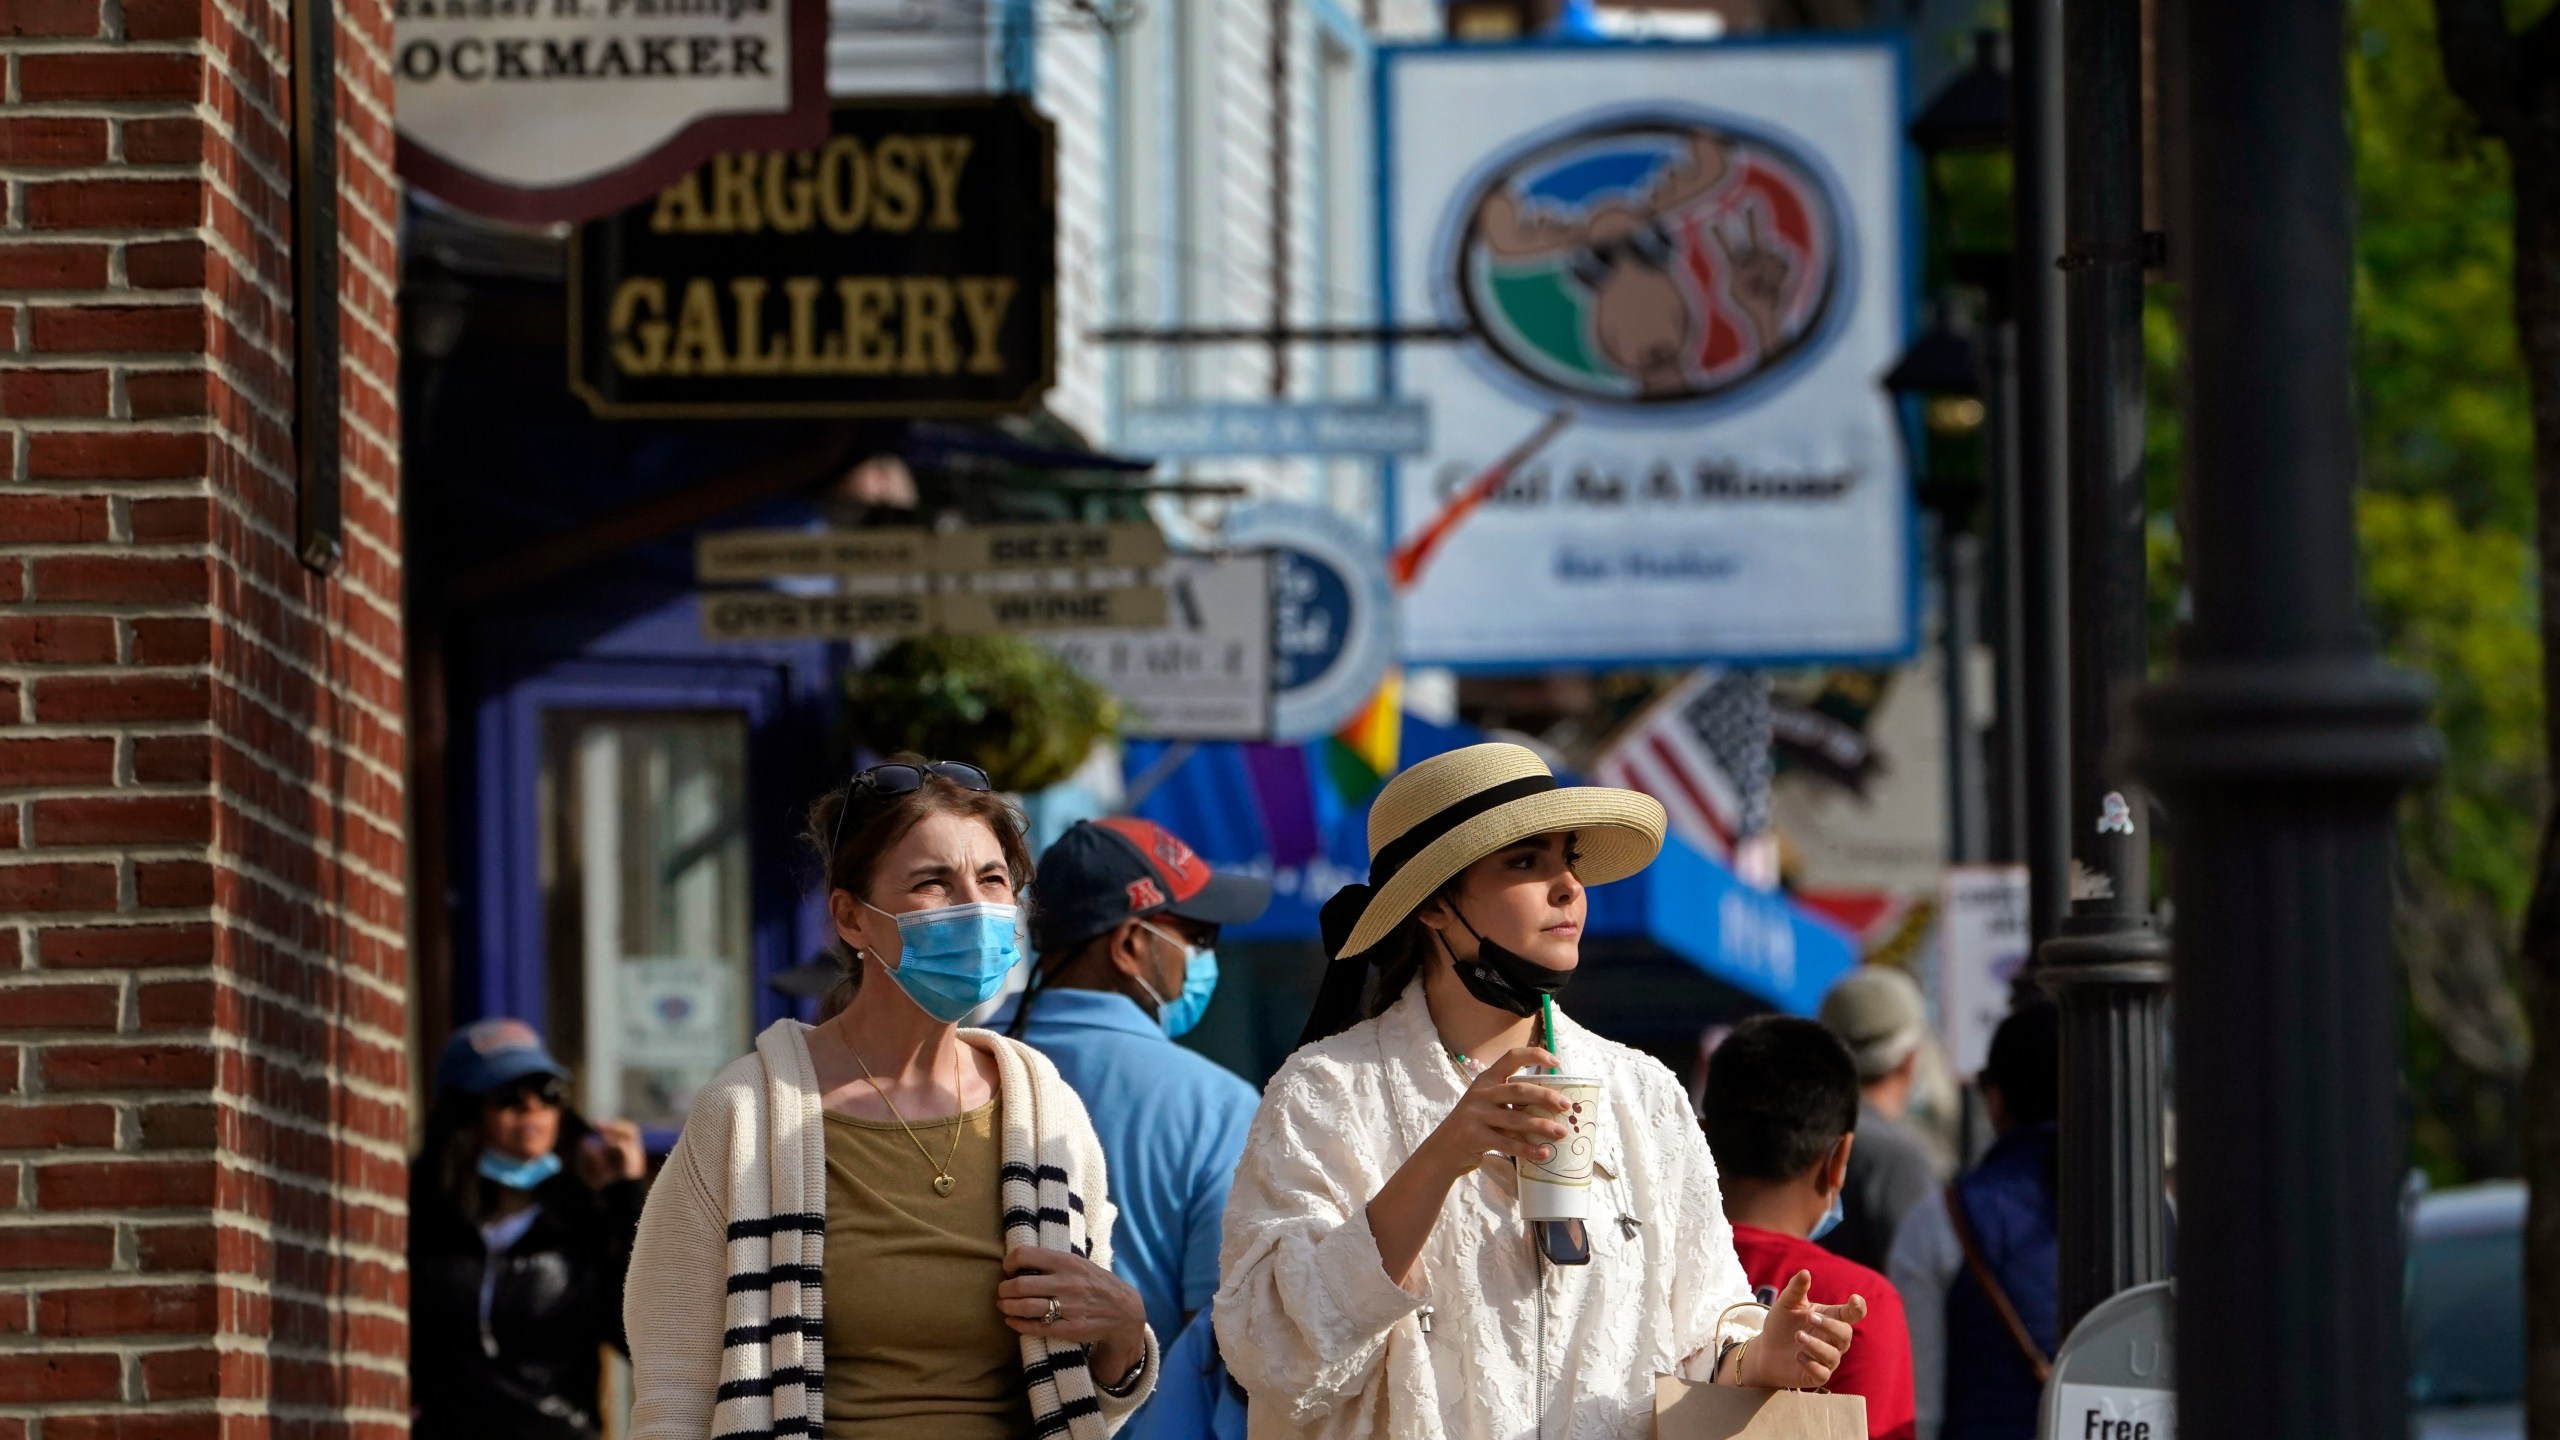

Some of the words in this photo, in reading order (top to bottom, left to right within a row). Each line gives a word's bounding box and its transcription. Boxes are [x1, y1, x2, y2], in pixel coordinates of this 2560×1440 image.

[396, 33, 773, 82] OCKMAKER
[649, 134, 975, 234] ARGOSY
[608, 276, 1017, 377] GALLERY
[989, 530, 1109, 564] BEER
[712, 598, 921, 634] OYSTERS
[990, 597, 1109, 624] WINE
[2085, 1408, 2150, 1440] Free
